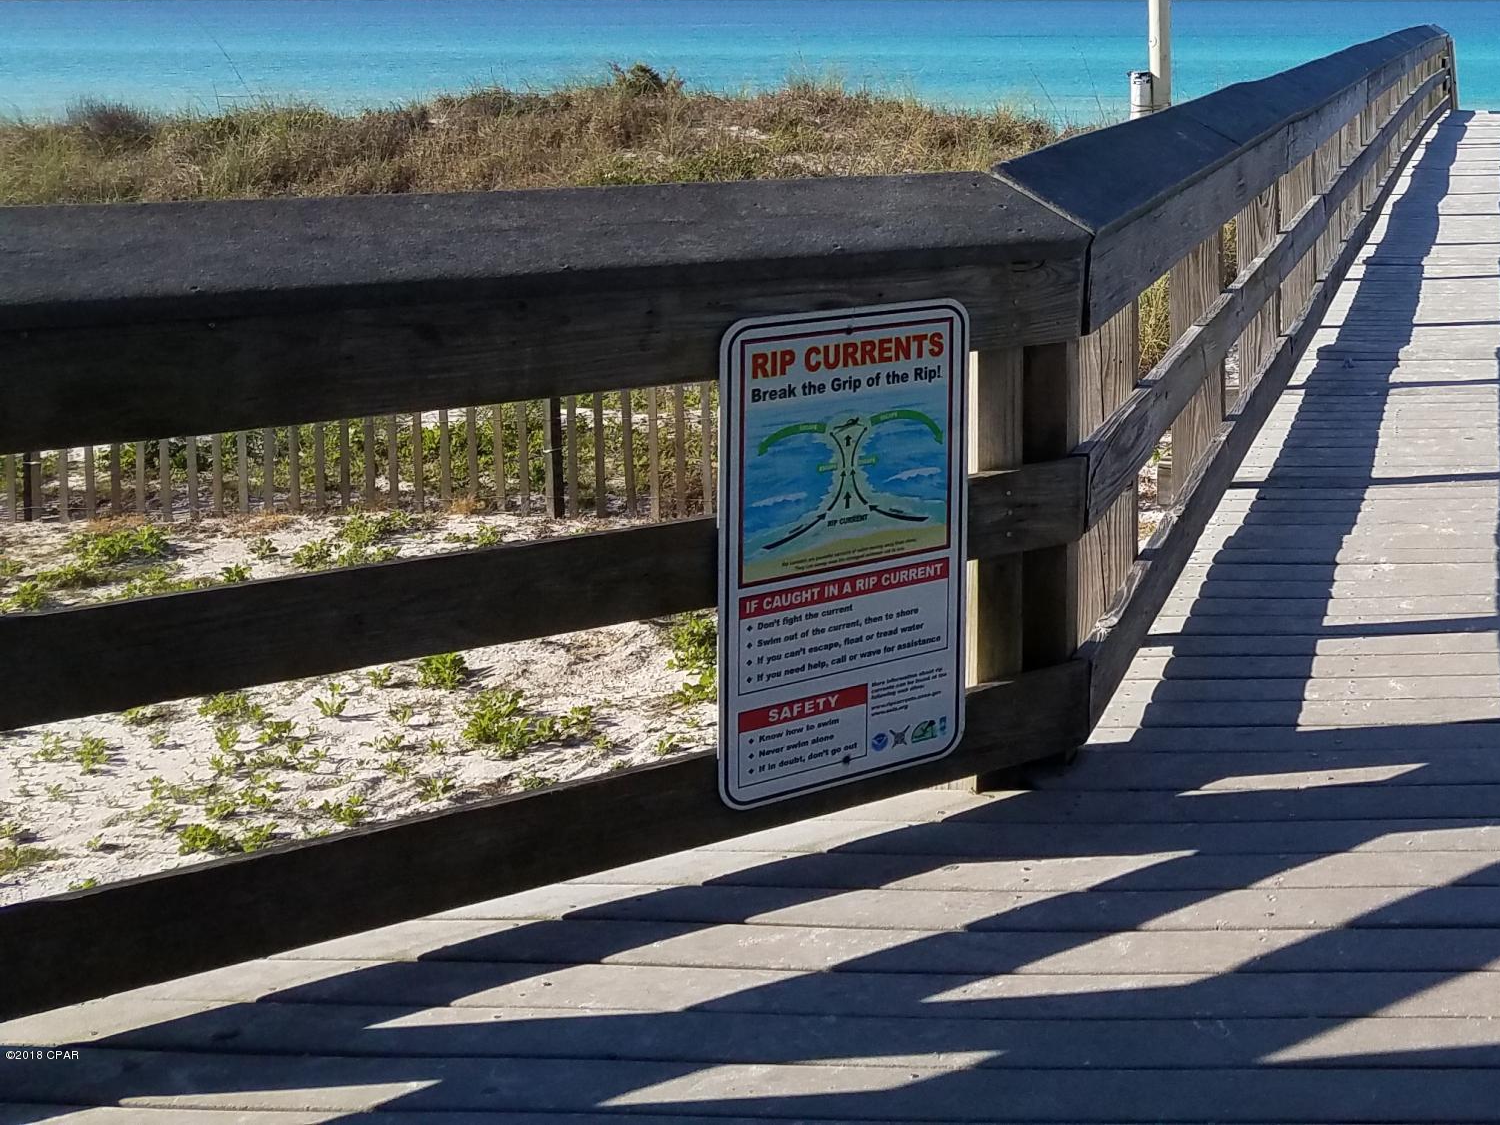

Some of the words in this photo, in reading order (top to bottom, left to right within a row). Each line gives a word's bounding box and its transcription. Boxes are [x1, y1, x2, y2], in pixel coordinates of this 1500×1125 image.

[752, 349, 796, 379] RIP
[804, 332, 944, 372] CURRENTS
[751, 383, 797, 403] Break
[801, 381, 826, 396] the
[831, 375, 861, 393] Grip
[867, 372, 881, 387] of
[886, 370, 909, 385] the
[914, 365, 942, 383] Rip!
[745, 599, 759, 614] IF
[763, 587, 820, 610] CAUGHT
[824, 583, 838, 598] IN
[842, 581, 852, 594] A
[856, 575, 878, 592] RIP
[881, 563, 944, 586] CURRENT
[757, 618, 781, 631] Don't
[782, 614, 803, 626] fight
[805, 610, 819, 621] the
[821, 604, 853, 617] current
[757, 636, 782, 648] Swim
[784, 632, 798, 642] out
[800, 629, 809, 640] of
[811, 626, 826, 636] the
[828, 618, 862, 633] current,
[864, 613, 883, 624] then
[885, 611, 894, 620] to
[895, 607, 919, 619] shore
[757, 655, 764, 665] If
[766, 653, 782, 665] you
[784, 647, 806, 659] can't
[808, 640, 842, 655] escape,
[844, 634, 863, 646] float
[865, 633, 874, 641] or
[876, 628, 899, 640] tread
[900, 622, 924, 634] water
[757, 672, 764, 682] If
[766, 670, 782, 682] you
[784, 664, 806, 676] need
[807, 658, 829, 671] help,
[831, 654, 847, 666] call
[848, 653, 858, 661] or
[859, 648, 882, 659] wave
[883, 644, 896, 653] for
[897, 635, 941, 651] assistance
[768, 694, 840, 722] SAFETY
[758, 732, 783, 743] Know
[785, 726, 804, 738] how
[806, 723, 815, 731] to
[817, 717, 840, 728] swim
[758, 746, 784, 759] Never
[786, 739, 809, 751] swim
[811, 733, 835, 746] alone
[758, 764, 766, 773] If
[767, 761, 776, 771] in
[778, 754, 806, 768] doubt,
[807, 748, 829, 762] don't
[831, 746, 842, 757] go
[843, 742, 858, 752] out
